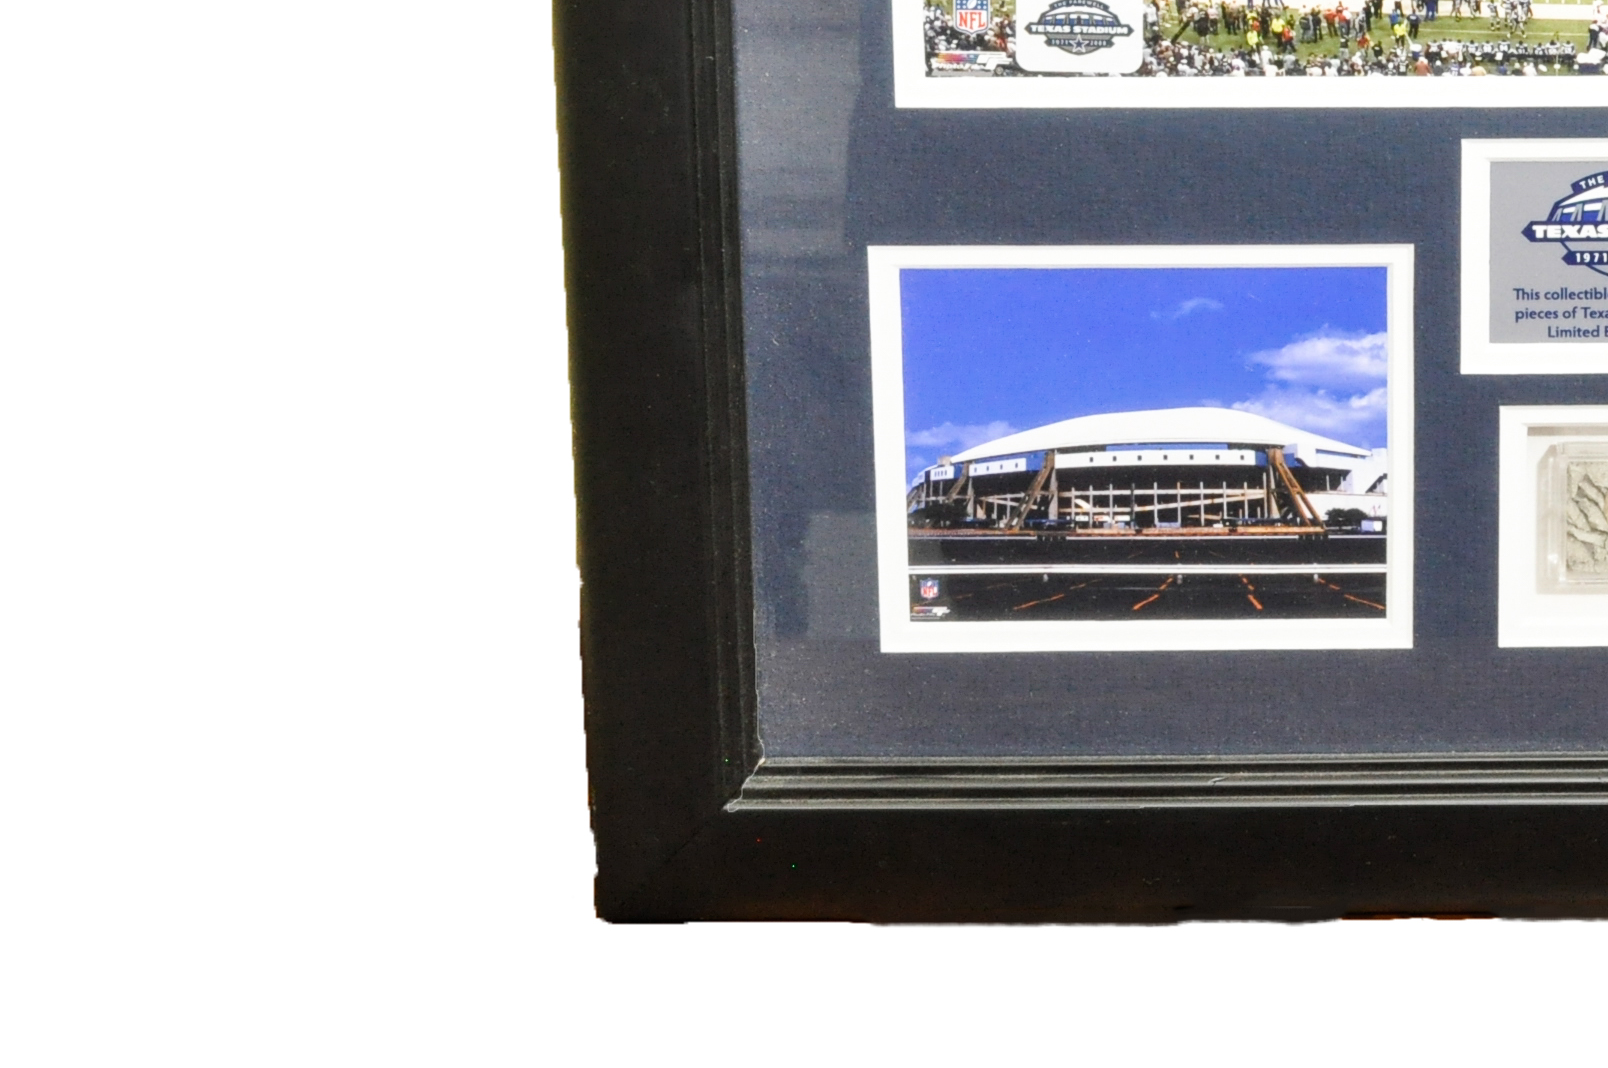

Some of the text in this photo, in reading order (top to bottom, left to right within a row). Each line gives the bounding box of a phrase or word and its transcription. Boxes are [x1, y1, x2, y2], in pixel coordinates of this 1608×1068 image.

[958, 11, 986, 30] NFL
[1030, 24, 1129, 34] TEXAS STADIUM
[1578, 175, 1605, 190] THE
[1575, 252, 1608, 263] 1971
[1512, 287, 1541, 301] This
[1514, 308, 1559, 323] pieces
[1561, 305, 1579, 320] of
[1547, 324, 1601, 339] Limited
